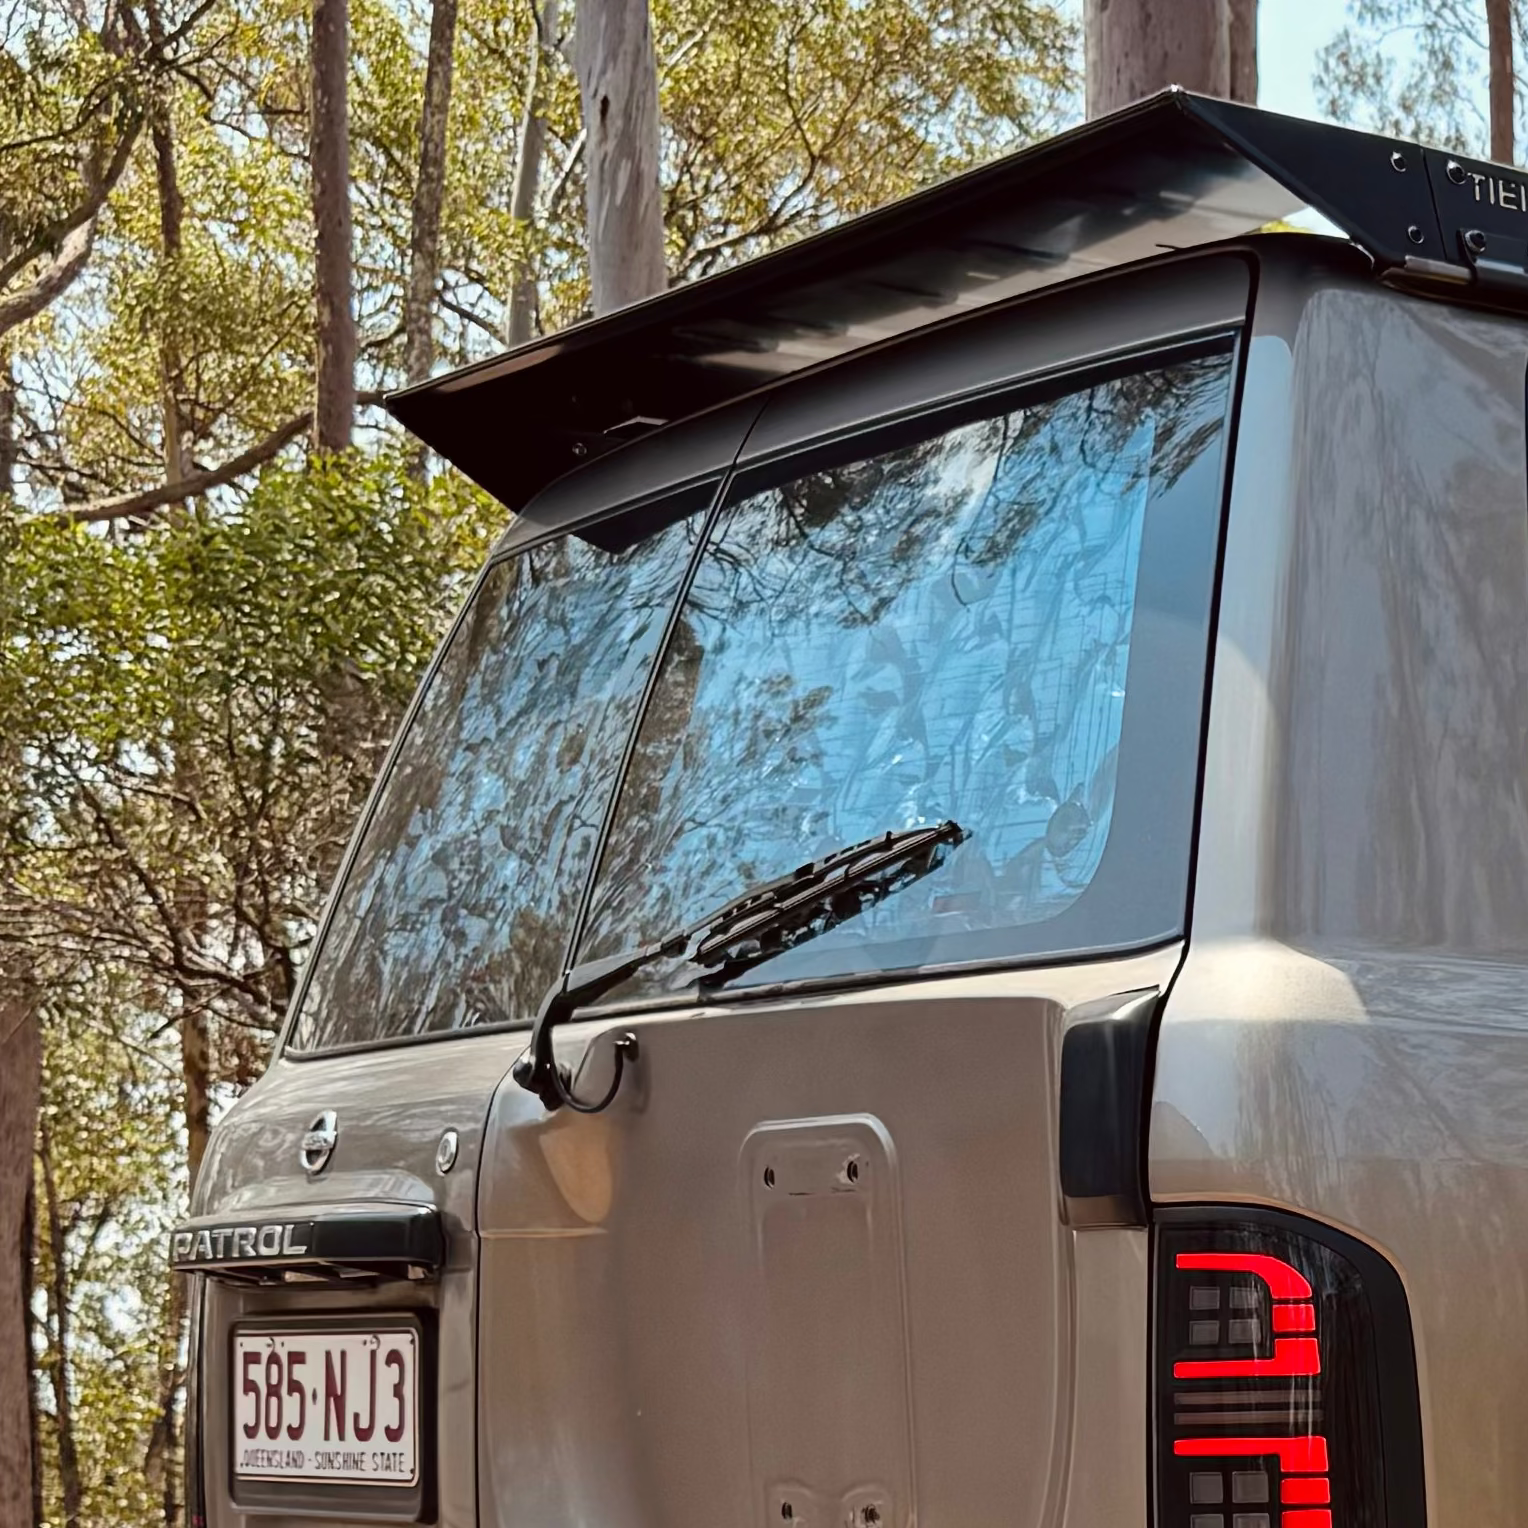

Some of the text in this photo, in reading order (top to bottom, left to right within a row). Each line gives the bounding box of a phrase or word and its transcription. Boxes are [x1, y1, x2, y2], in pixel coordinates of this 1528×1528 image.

[172, 1224, 308, 1262] PATROL
[314, 1451, 366, 1472] SUNSHINE
[372, 1452, 405, 1473] STATE
